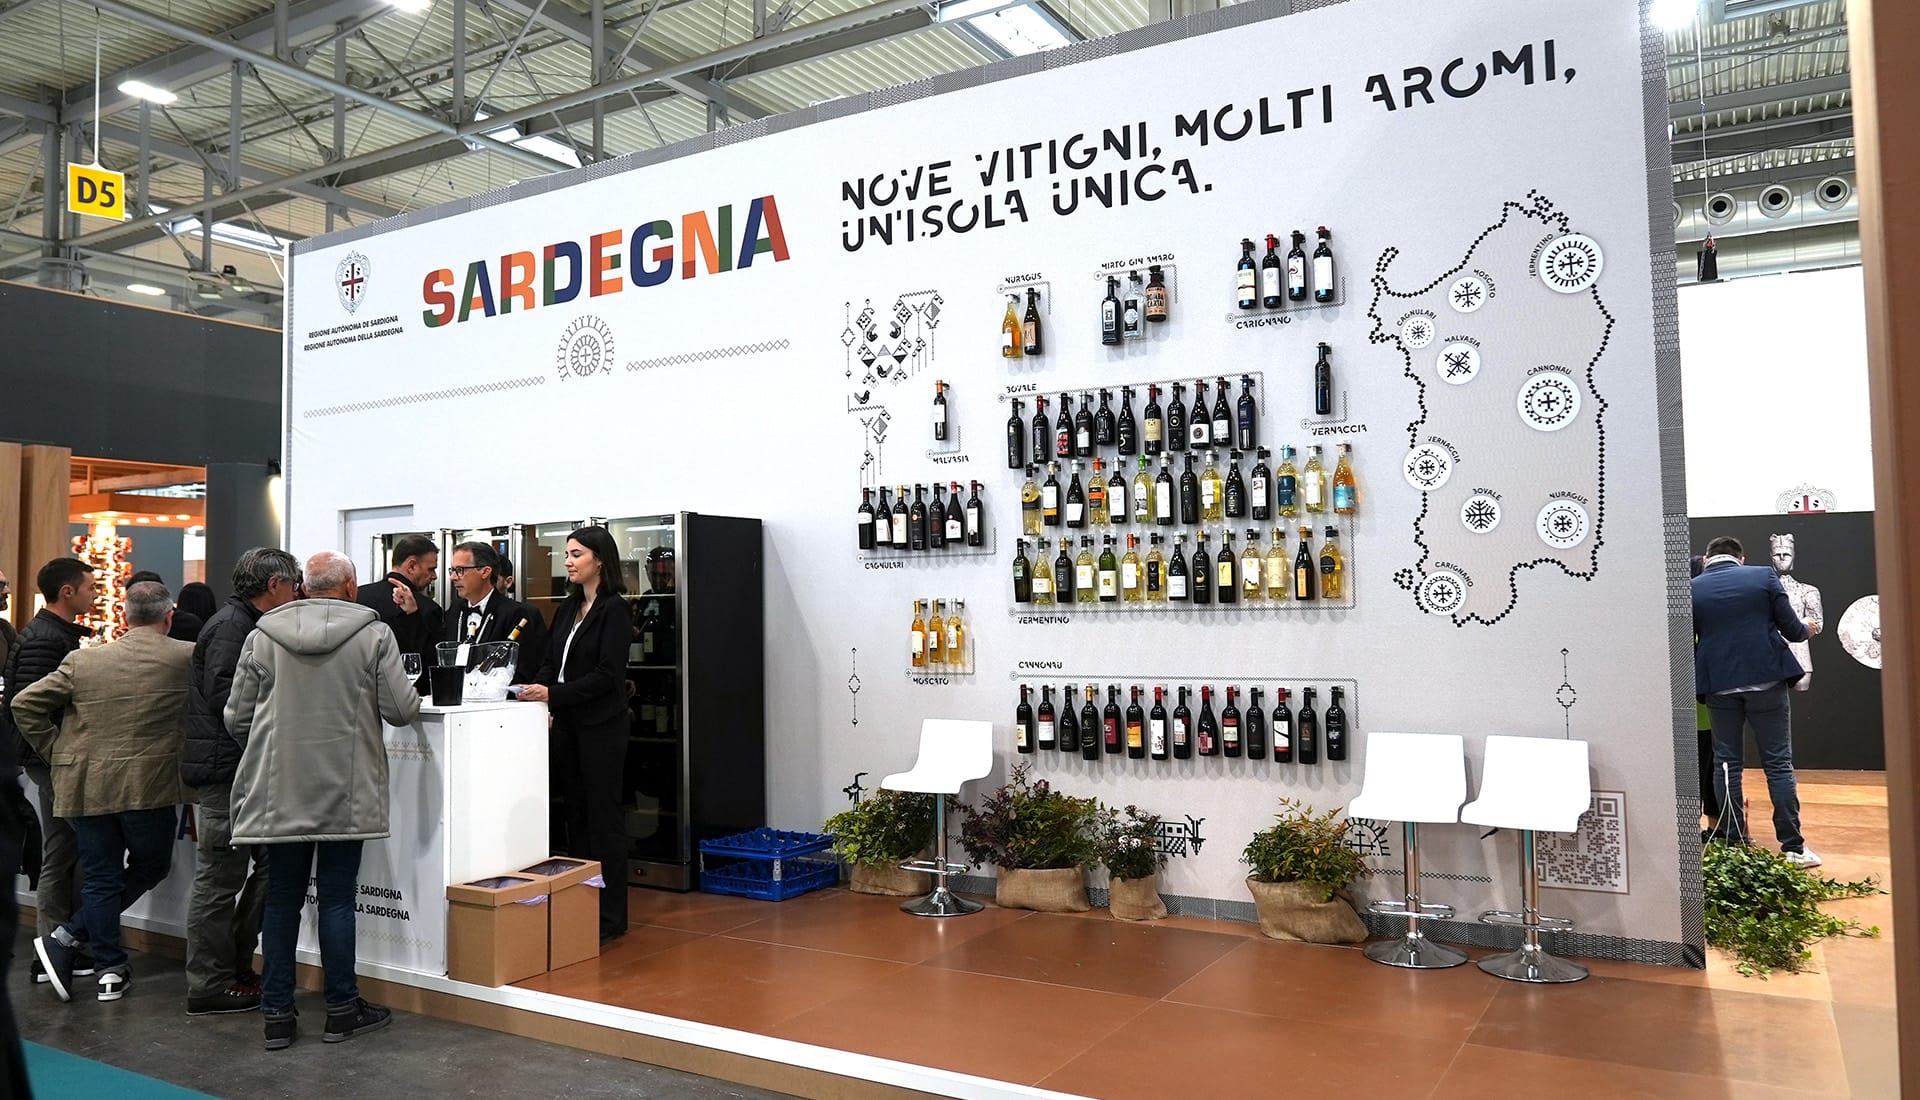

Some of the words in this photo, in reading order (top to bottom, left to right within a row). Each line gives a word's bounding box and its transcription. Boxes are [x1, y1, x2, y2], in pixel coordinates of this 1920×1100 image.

[842, 160, 952, 210] NOVE
[975, 121, 1162, 187] VITIGNI,
[1175, 84, 1333, 147] MOLTI
[1364, 39, 1577, 111] AROMI,
[77, 175, 116, 208] D5
[422, 194, 790, 329] SARDEGNA
[1101, 260, 1126, 270] MIRTO
[1128, 256, 1144, 266] GIN
[1147, 252, 1175, 264] AMARO
[1528, 233, 1554, 279] VERMENTINO
[1005, 272, 1042, 284] NURAGUS
[1473, 268, 1496, 299] MOSCATO
[1236, 315, 1292, 329] CARIGNANO
[1396, 308, 1437, 327] CAGNULARI
[309, 329, 330, 339] REGIONE
[370, 315, 398, 327] SARDIGNA
[304, 341, 325, 351] REGIONE
[326, 336, 356, 347] AUTONOMA
[357, 333, 373, 341] DELLA
[374, 327, 403, 338] SARDEGNA
[1444, 335, 1481, 348] MALVASIA
[1526, 364, 1572, 376] CANNONAU
[1006, 383, 1037, 394] BOVALE
[1312, 424, 1367, 436] VERNACCIA
[1427, 435, 1462, 464] VERNACCIA
[932, 455, 970, 465] MALVASIA
[1472, 487, 1503, 501] BOVALE
[1549, 490, 1589, 505] NURAGUS
[864, 561, 904, 570] CAGNULARI
[1434, 561, 1474, 588] CARIGNANO
[1017, 616, 1070, 625] VERMENTINO
[1018, 661, 1063, 670] CANNONAU
[912, 677, 949, 686] MOSCATO
[360, 884, 403, 901] SARDIGNA
[366, 903, 410, 921] SARDEGNA
